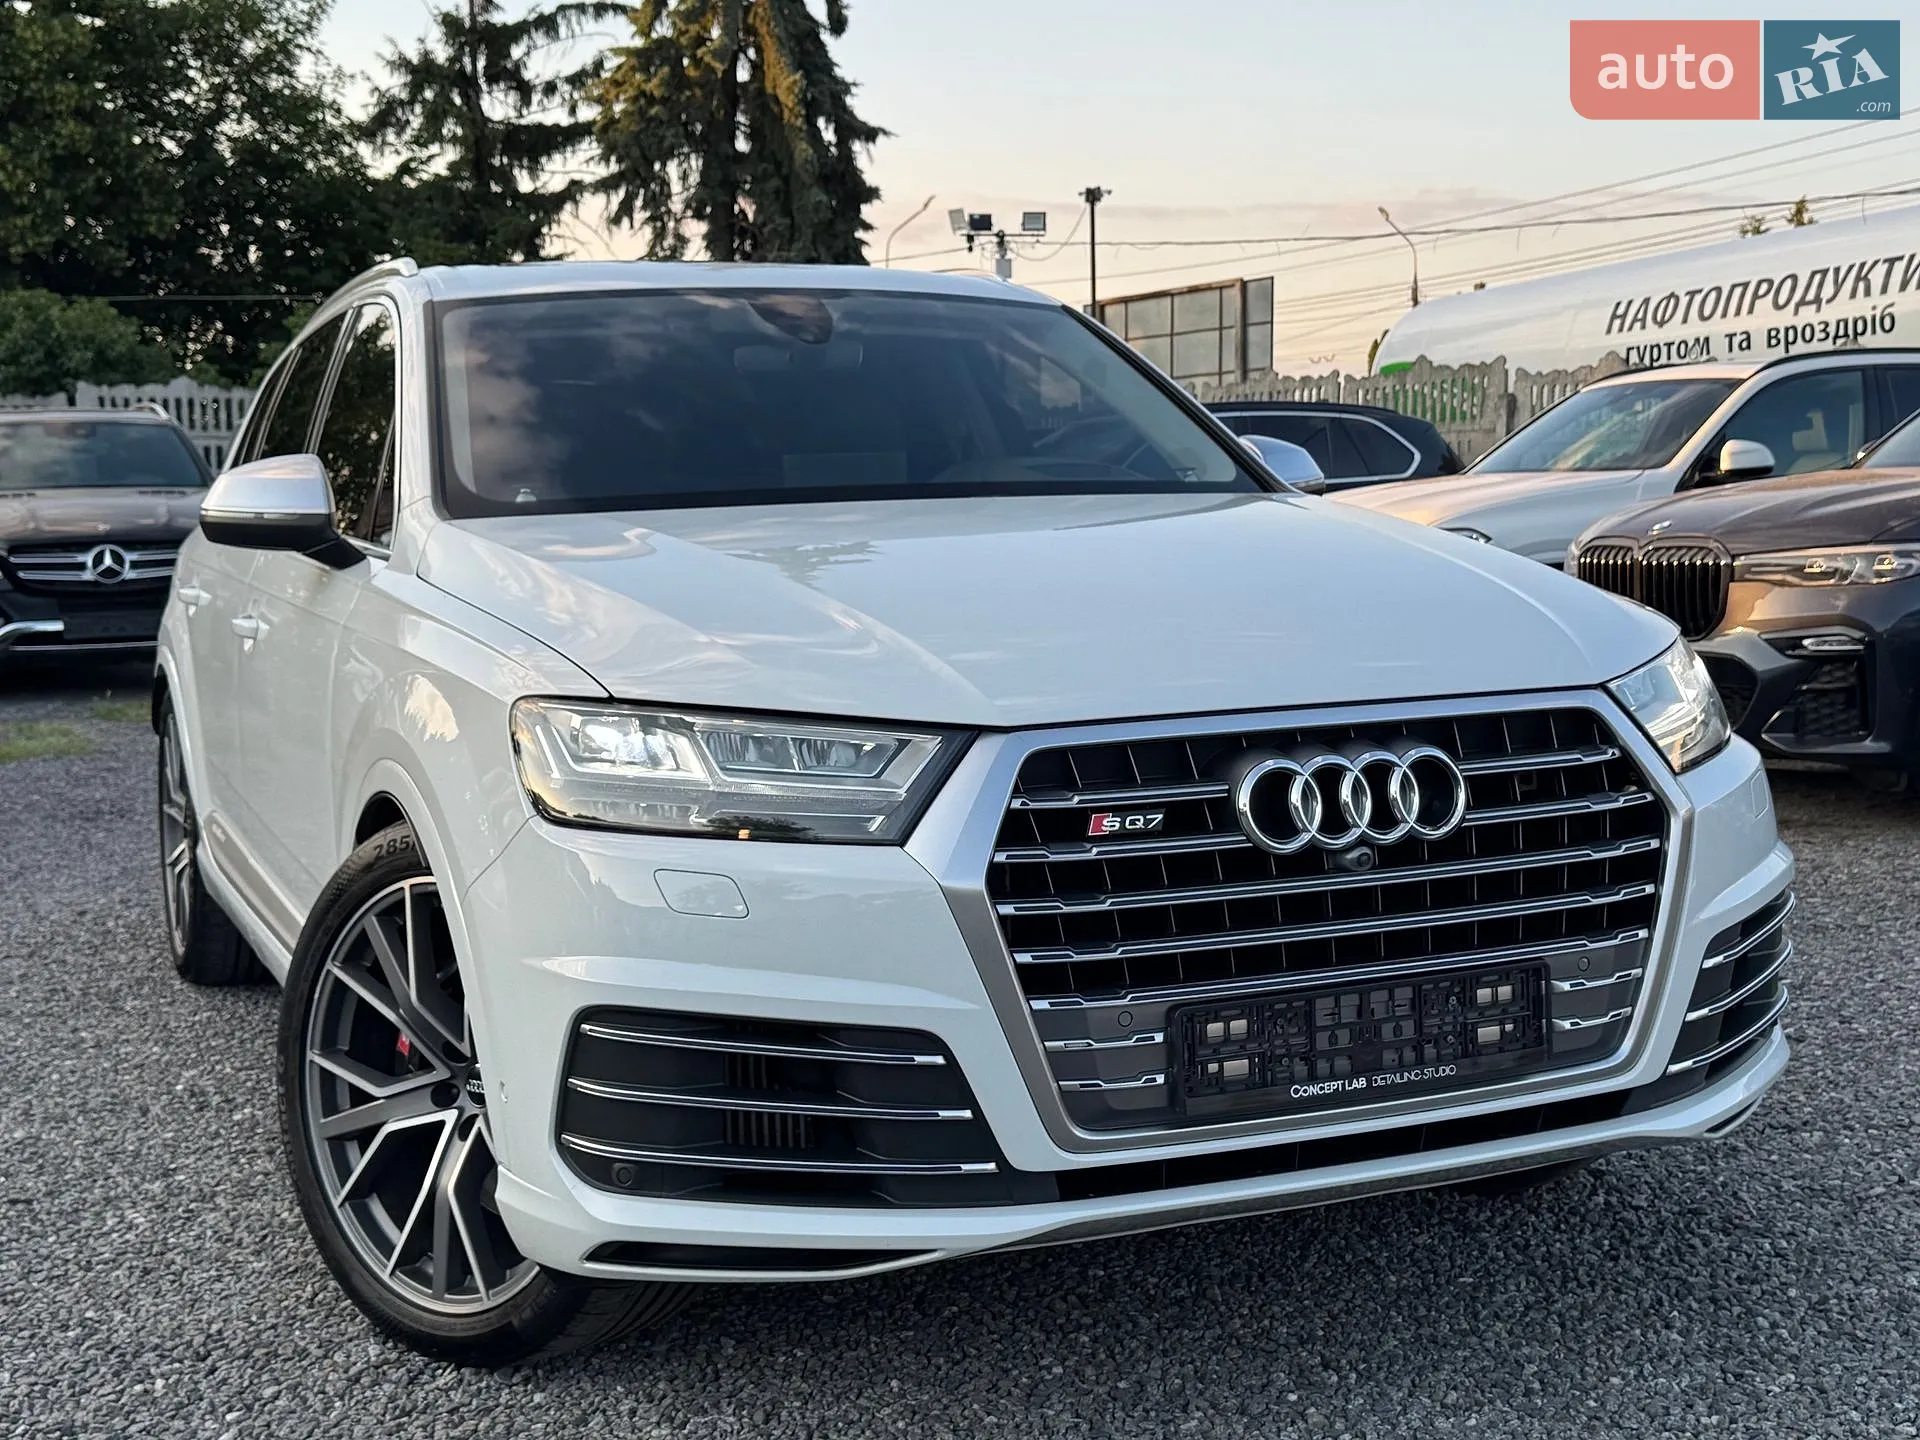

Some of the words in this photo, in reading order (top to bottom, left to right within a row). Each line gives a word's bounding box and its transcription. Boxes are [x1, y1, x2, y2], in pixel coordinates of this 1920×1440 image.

[1605, 252, 1920, 335] НАФТОПРОДУКТИ
[1625, 336, 1711, 367] гуртом
[1725, 330, 1751, 353] та
[1767, 302, 1896, 354] вроздріб
[1101, 814, 1164, 831] SQ7
[1290, 1080, 1344, 1098] CONCEPT
[1345, 1077, 1367, 1091] LAB
[1422, 1064, 1457, 1080] STUDIO
